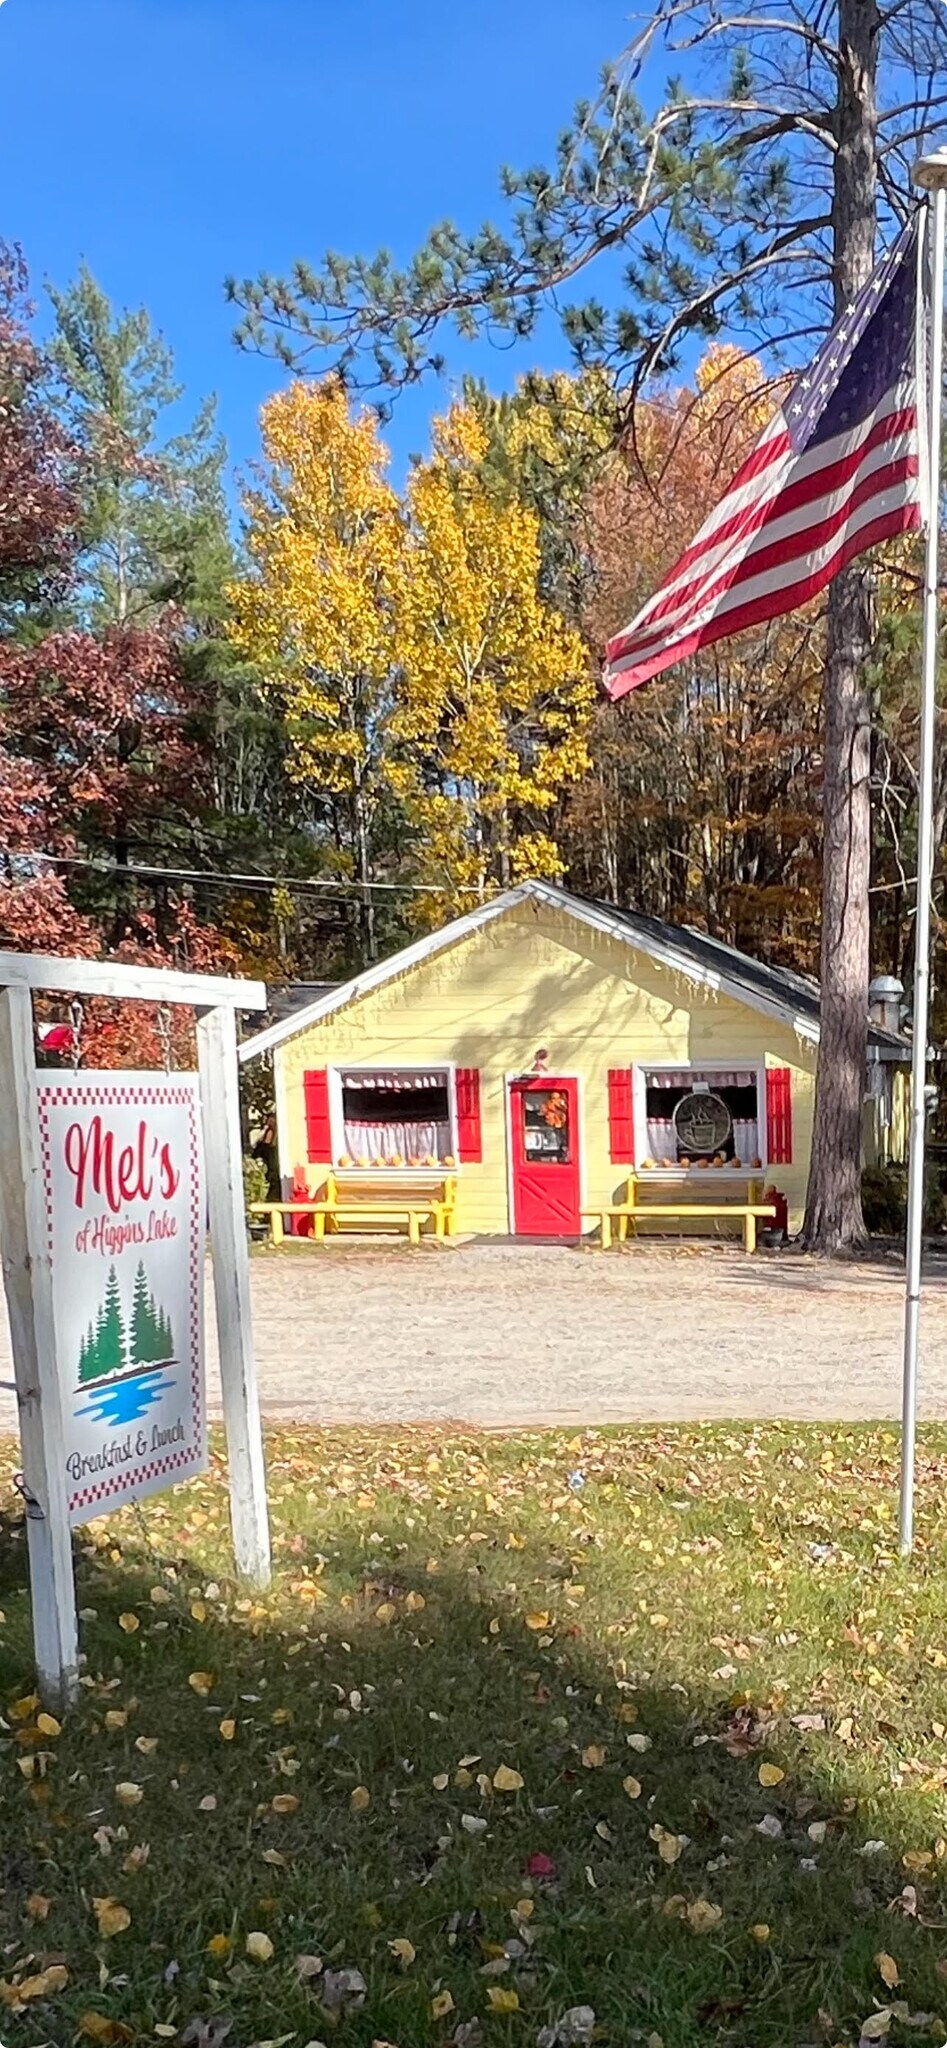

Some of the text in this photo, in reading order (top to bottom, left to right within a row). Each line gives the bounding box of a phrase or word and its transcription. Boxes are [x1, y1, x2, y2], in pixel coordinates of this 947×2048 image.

[65, 1115, 180, 1213] Mel's
[76, 1209, 177, 1257] of Higgins Lake
[66, 1417, 185, 1481] Breakfast & Lunch
